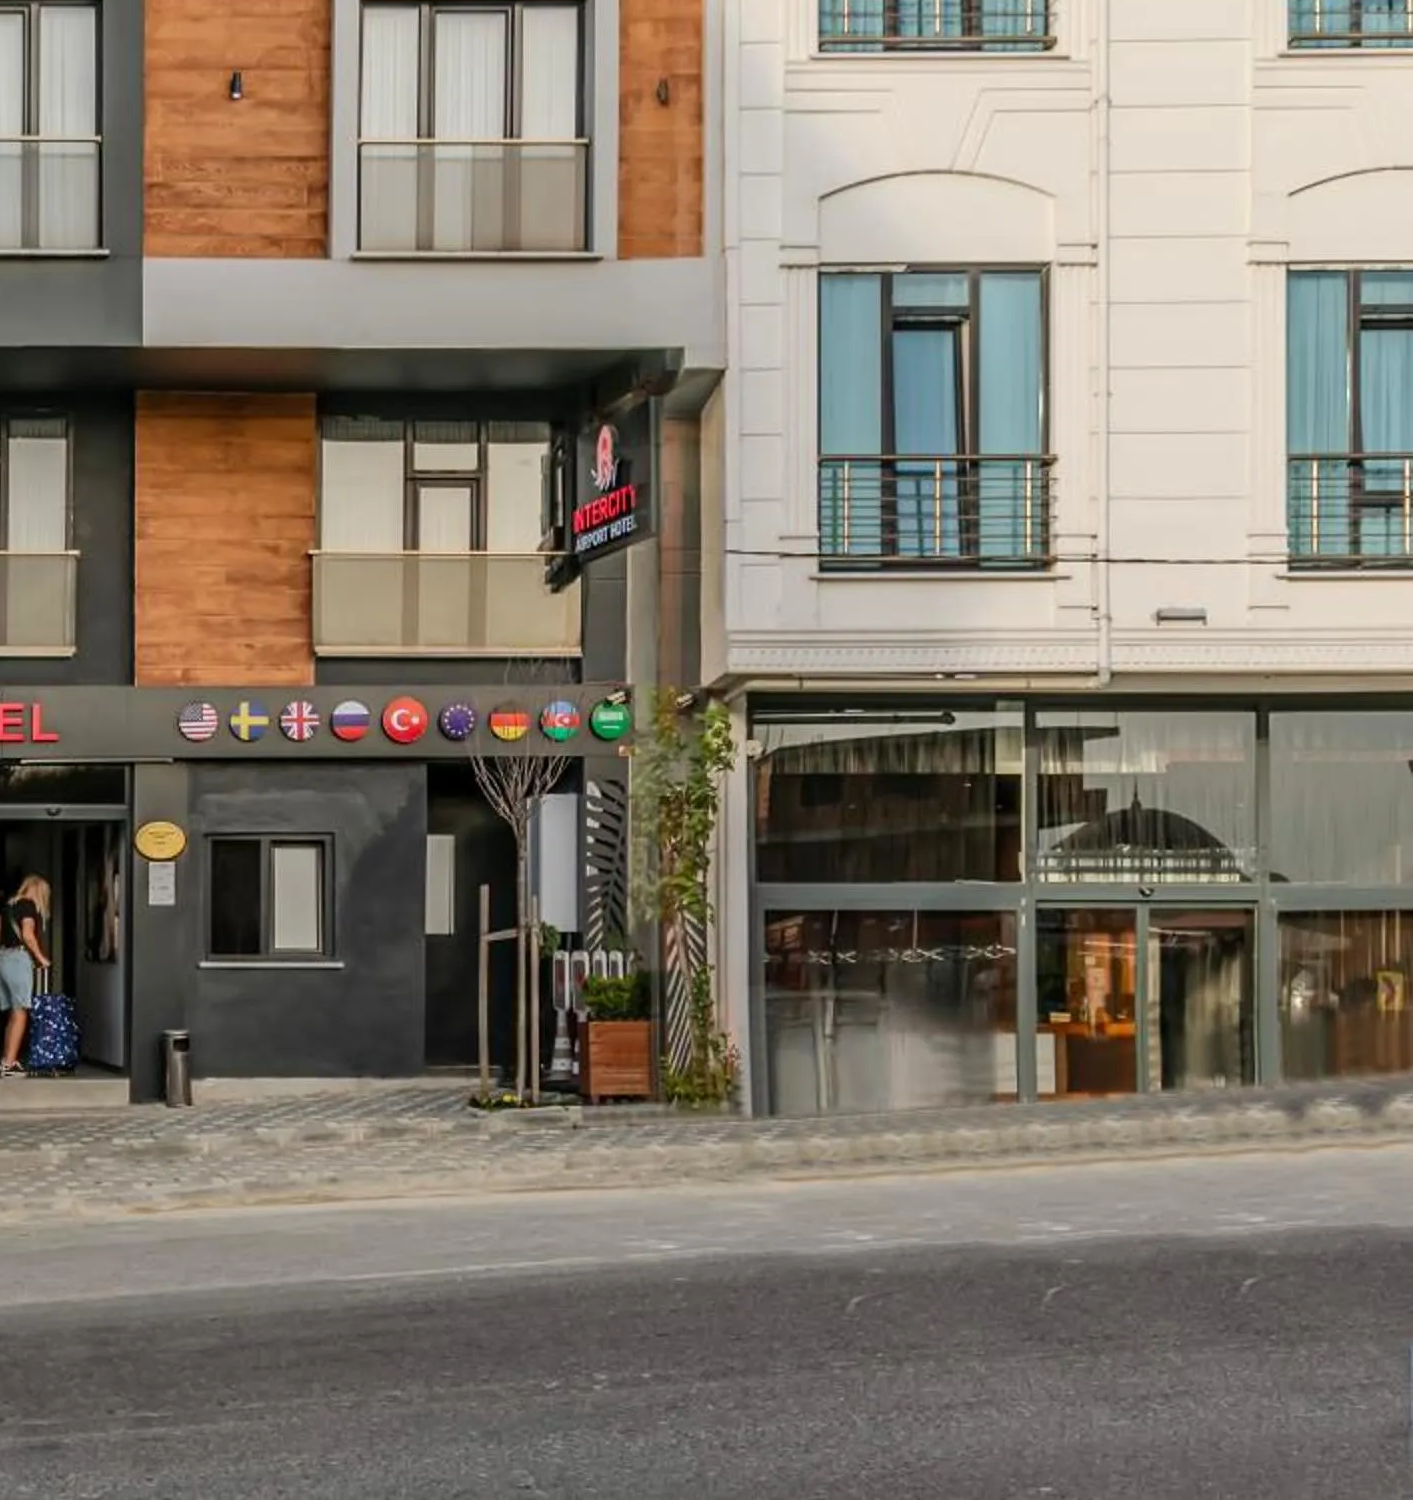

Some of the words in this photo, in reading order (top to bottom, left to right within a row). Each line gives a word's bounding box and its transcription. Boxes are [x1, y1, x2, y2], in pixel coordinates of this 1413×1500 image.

[573, 484, 636, 533] INTERCITY
[574, 526, 608, 553] AIRPORT
[610, 514, 638, 540] HOTEL
